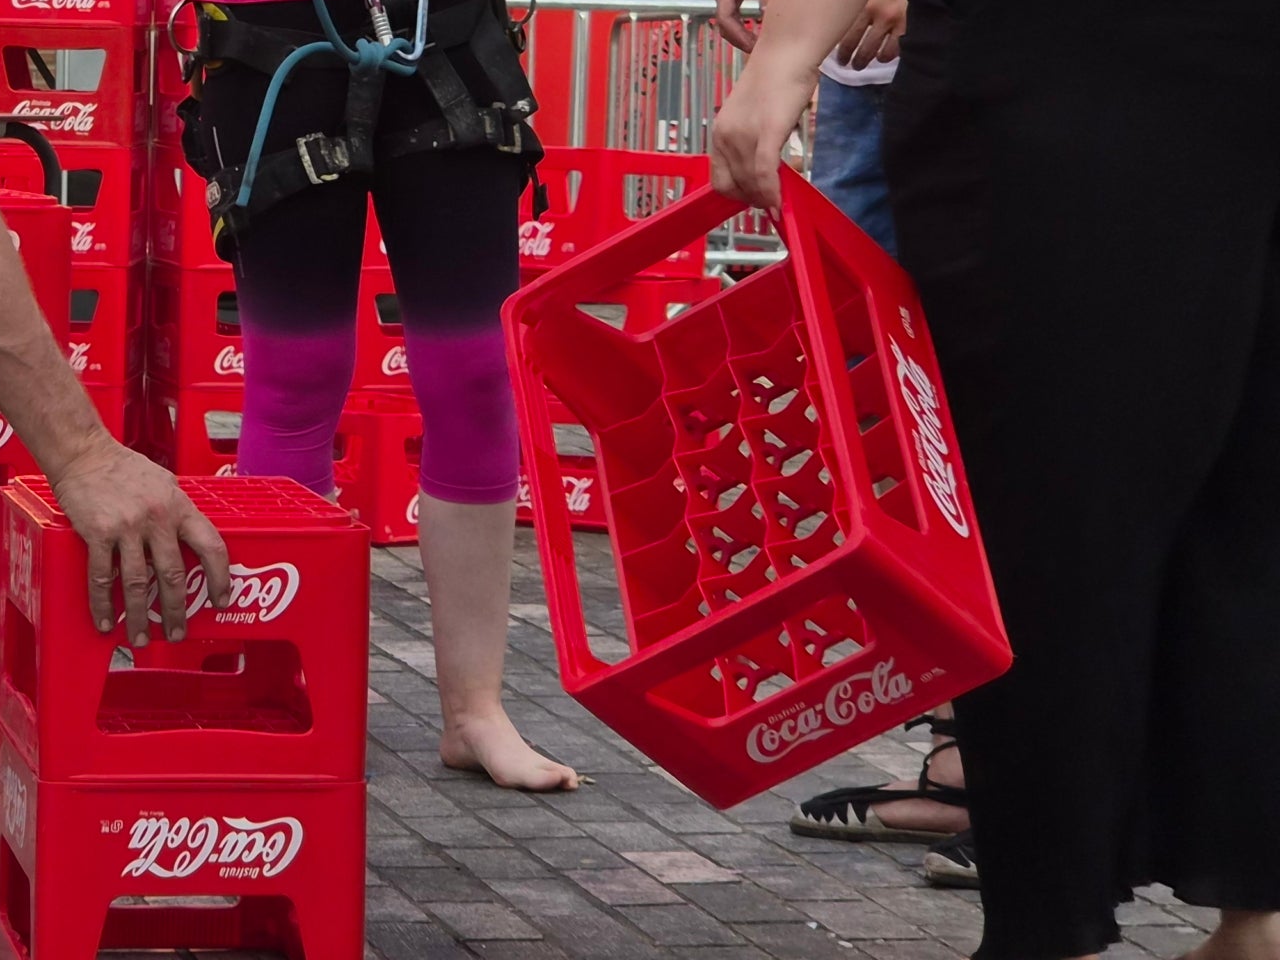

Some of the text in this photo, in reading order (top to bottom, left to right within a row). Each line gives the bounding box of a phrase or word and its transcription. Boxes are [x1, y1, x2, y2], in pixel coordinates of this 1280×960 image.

[889, 333, 969, 538] Coca-Cola
[216, 612, 257, 623] Disfruta
[746, 656, 913, 763] Coca-Cola
[120, 816, 304, 878] Coca-Cola
[220, 866, 260, 879] Disfruta
